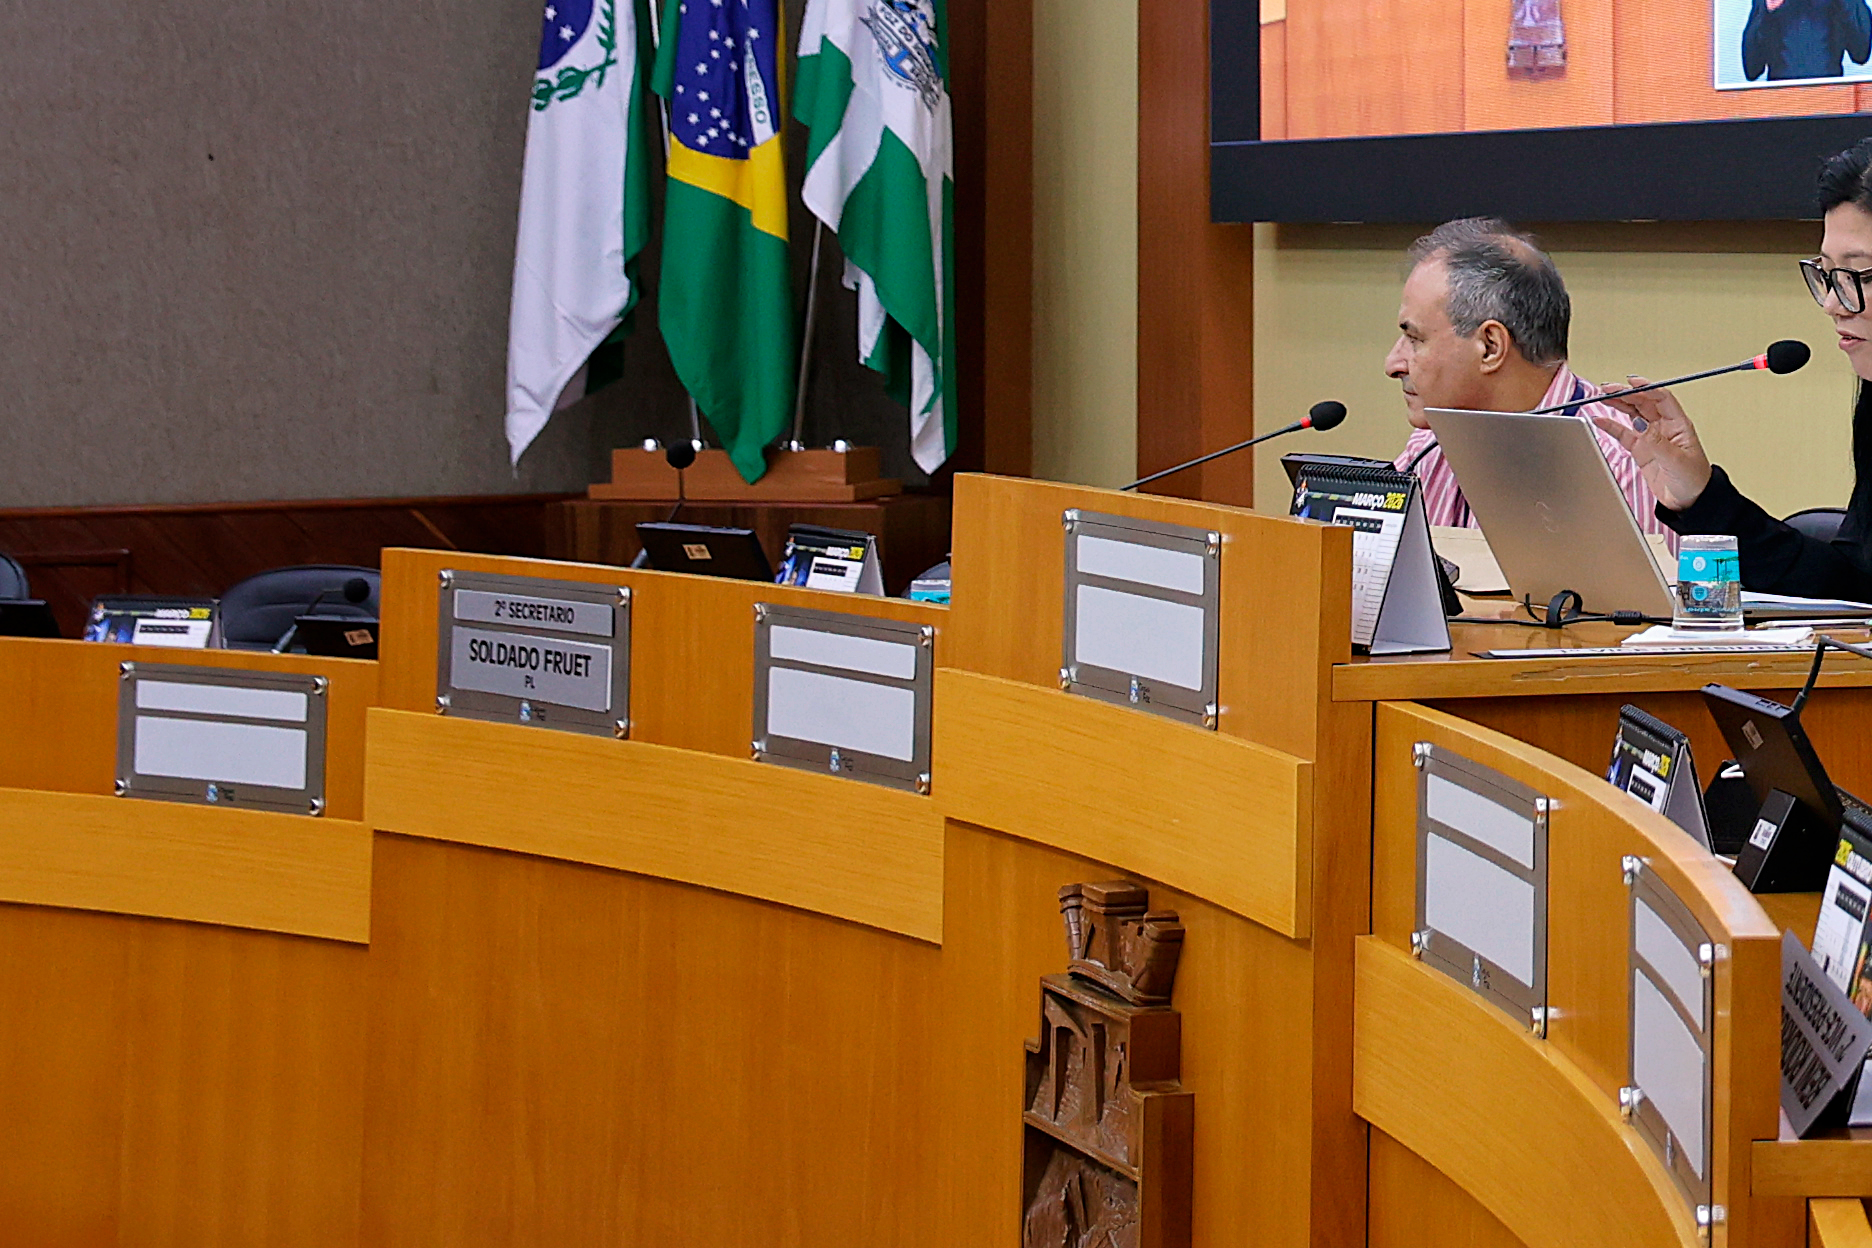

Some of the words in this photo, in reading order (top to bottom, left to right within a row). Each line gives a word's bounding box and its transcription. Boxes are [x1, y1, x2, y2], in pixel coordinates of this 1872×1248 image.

[1352, 492, 1385, 510] MARÇO
[469, 638, 540, 671] SOLDADO
[544, 649, 592, 678] FRUET
[524, 675, 535, 689] PL
